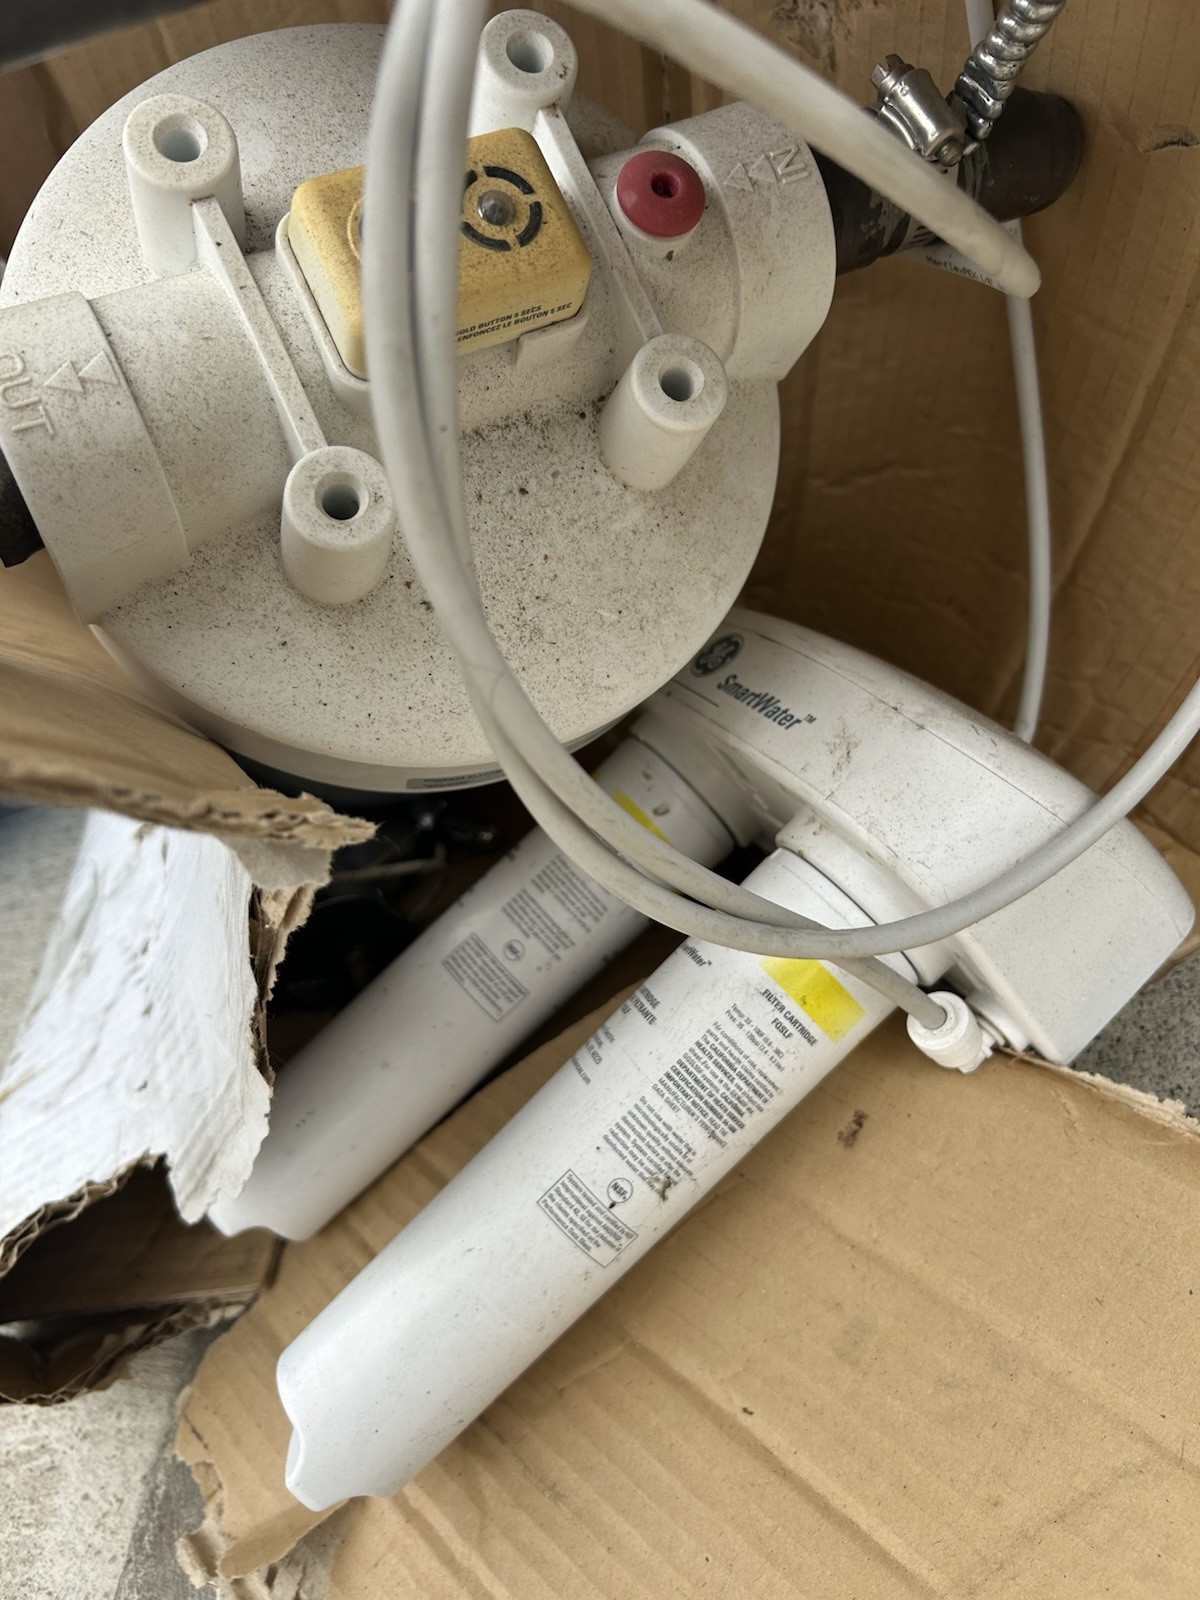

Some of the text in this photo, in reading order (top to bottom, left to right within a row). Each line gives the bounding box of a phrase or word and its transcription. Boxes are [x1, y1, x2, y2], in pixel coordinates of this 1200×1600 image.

[770, 144, 810, 184] IN
[456, 325, 476, 336] OLD
[478, 314, 513, 330] BUTTON
[521, 305, 542, 317] SECS
[457, 324, 502, 342] ENFONCEZ
[502, 320, 512, 329] LE
[514, 309, 550, 326] BOUTON
[555, 302, 573, 313] SEC
[0, 354, 55, 435] OUT
[762, 988, 817, 1046] FILTER CARTRIDGE
[713, 1021, 721, 1030] For
[720, 1030, 744, 1054] conditions
[718, 1040, 728, 1050] and
[727, 1049, 742, 1065] health
[695, 1040, 713, 1059] HEALTH
[712, 1058, 736, 1083] SERVICES,
[709, 1043, 737, 1072] CALIFORNIA
[736, 1071, 763, 1099] DEPARTMENT
[652, 1084, 665, 1097] DATA
[664, 1071, 691, 1100] IMPORTANT
[708, 1117, 720, 1129] READ
[670, 1065, 703, 1100] CERTIFICATION
[676, 1059, 707, 1092] DEPARTMENT
[706, 1090, 713, 1098] OF
[727, 1111, 744, 1129] SERVICES
[720, 1091, 744, 1117] CALIFORNIA
